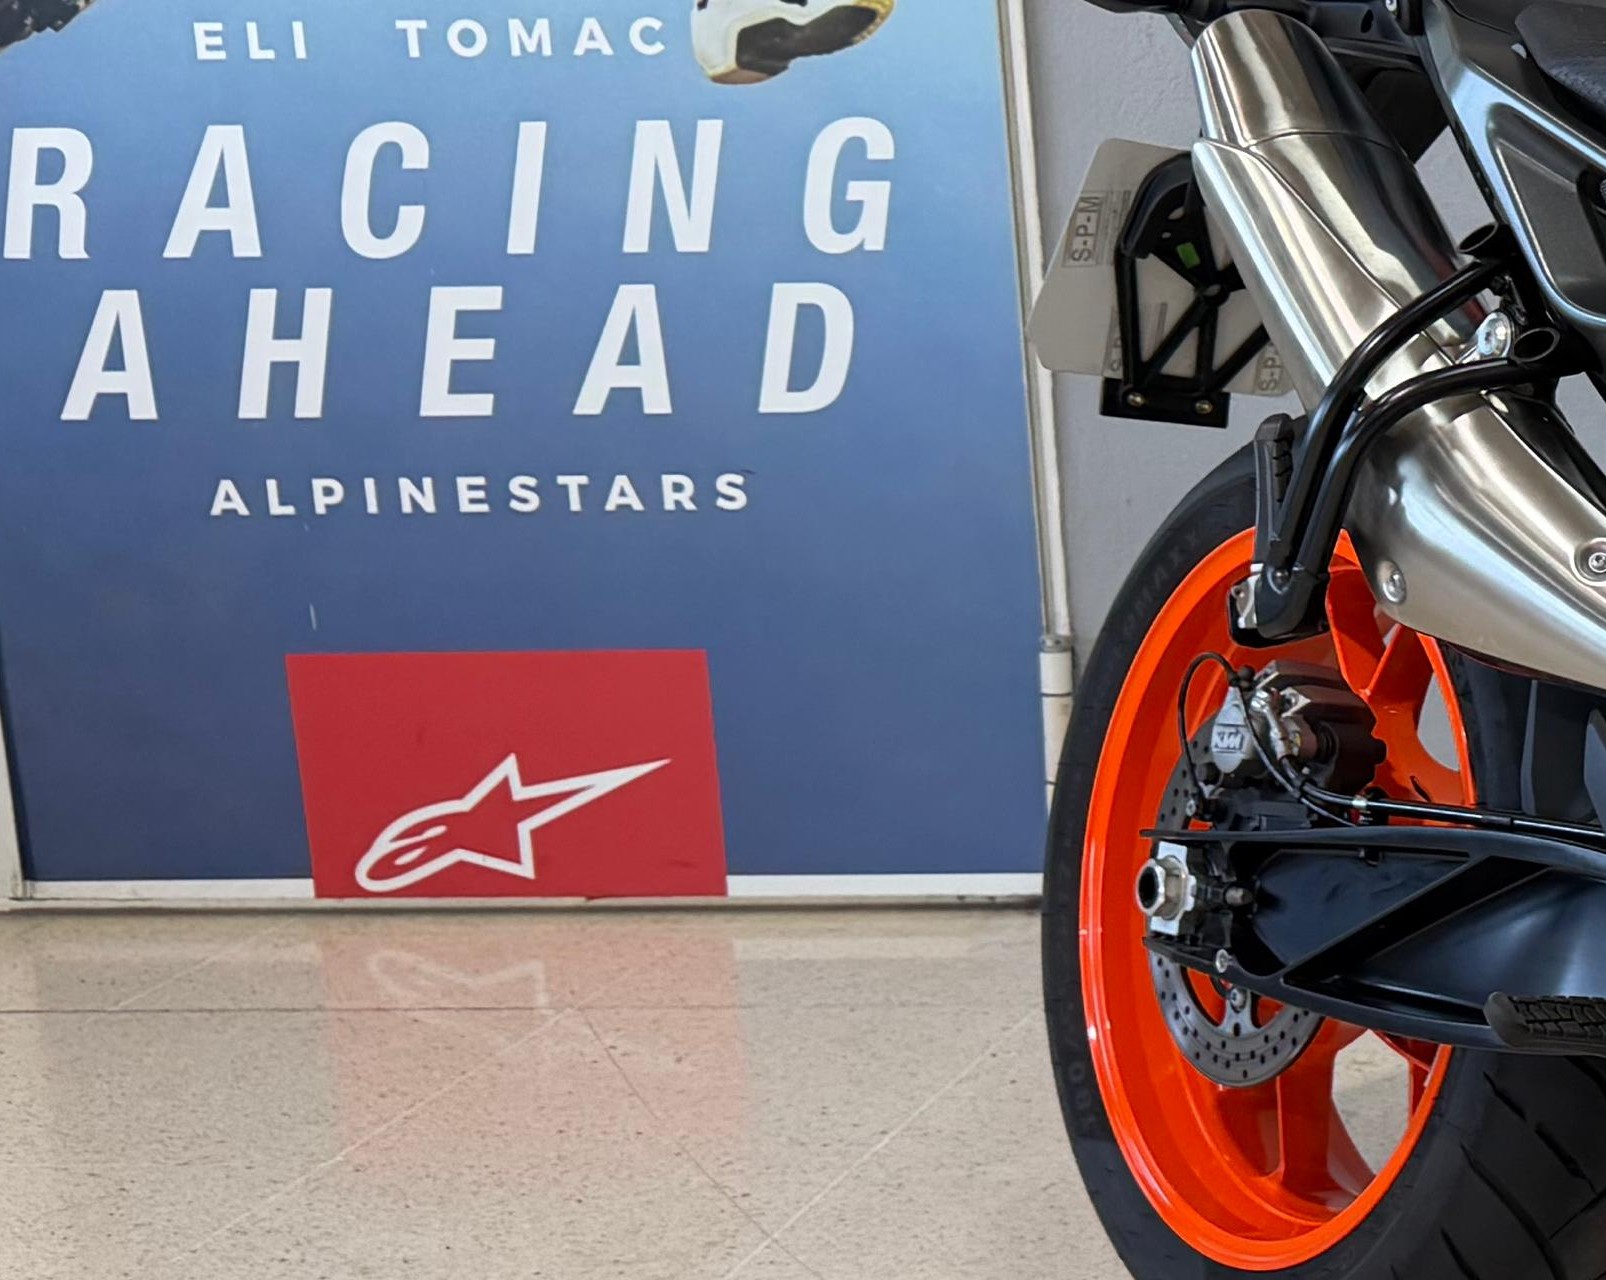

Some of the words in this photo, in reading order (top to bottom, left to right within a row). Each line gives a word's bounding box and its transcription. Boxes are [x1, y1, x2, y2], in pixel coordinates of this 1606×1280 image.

[193, 21, 308, 60] ELI
[394, 16, 666, 58] TOMAC
[3, 116, 896, 260] RACING
[1070, 195, 1101, 263] S-P-M
[60, 282, 855, 421] AHEAD
[210, 473, 748, 516] ALPINESTARS
[1213, 727, 1245, 751] KTM
